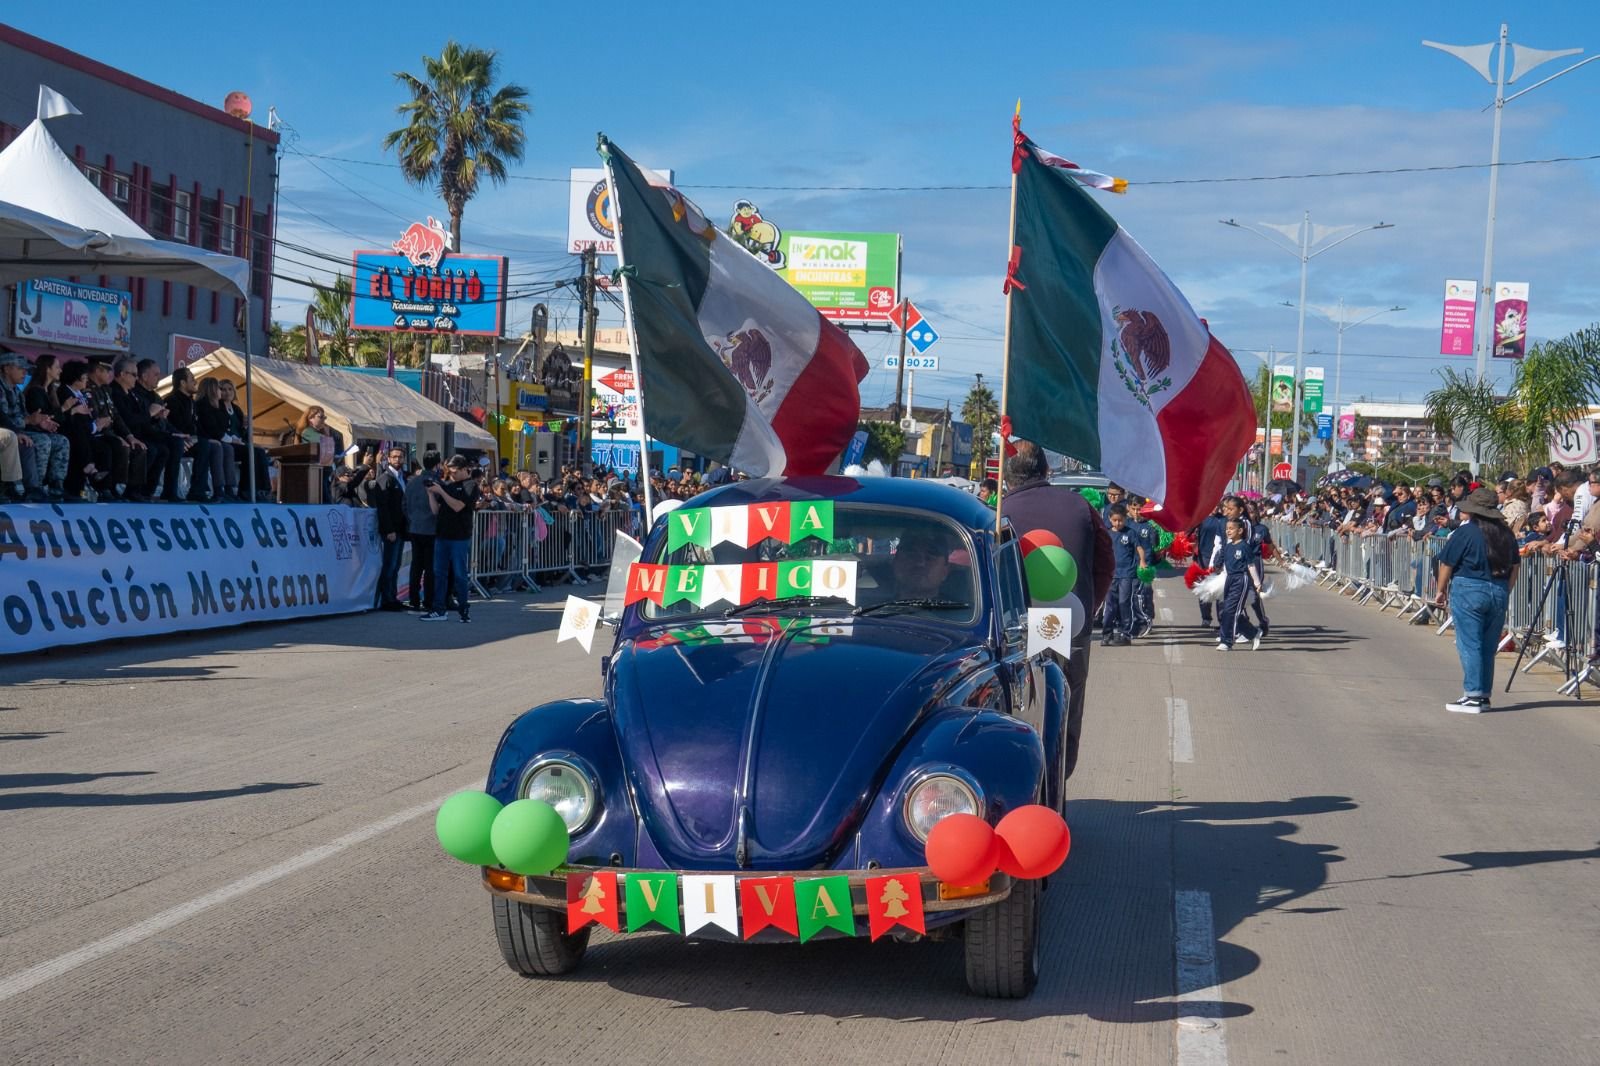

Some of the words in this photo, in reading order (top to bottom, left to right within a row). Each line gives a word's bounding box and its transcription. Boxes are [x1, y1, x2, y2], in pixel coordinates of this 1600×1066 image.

[33, 279, 72, 297] ZAPATERIA
[77, 288, 118, 305] NOVEDADES
[370, 274, 391, 297] EL
[402, 275, 481, 301] TORITO
[906, 358, 920, 367] 90
[923, 359, 935, 367] 22
[0, 504, 244, 561] Aniversario
[252, 508, 287, 549] de
[287, 508, 323, 549] la
[679, 505, 824, 537] VIVA
[187, 560, 329, 616] Mexicana
[635, 564, 847, 593] MÉXICO
[637, 879, 841, 920] VIVA
